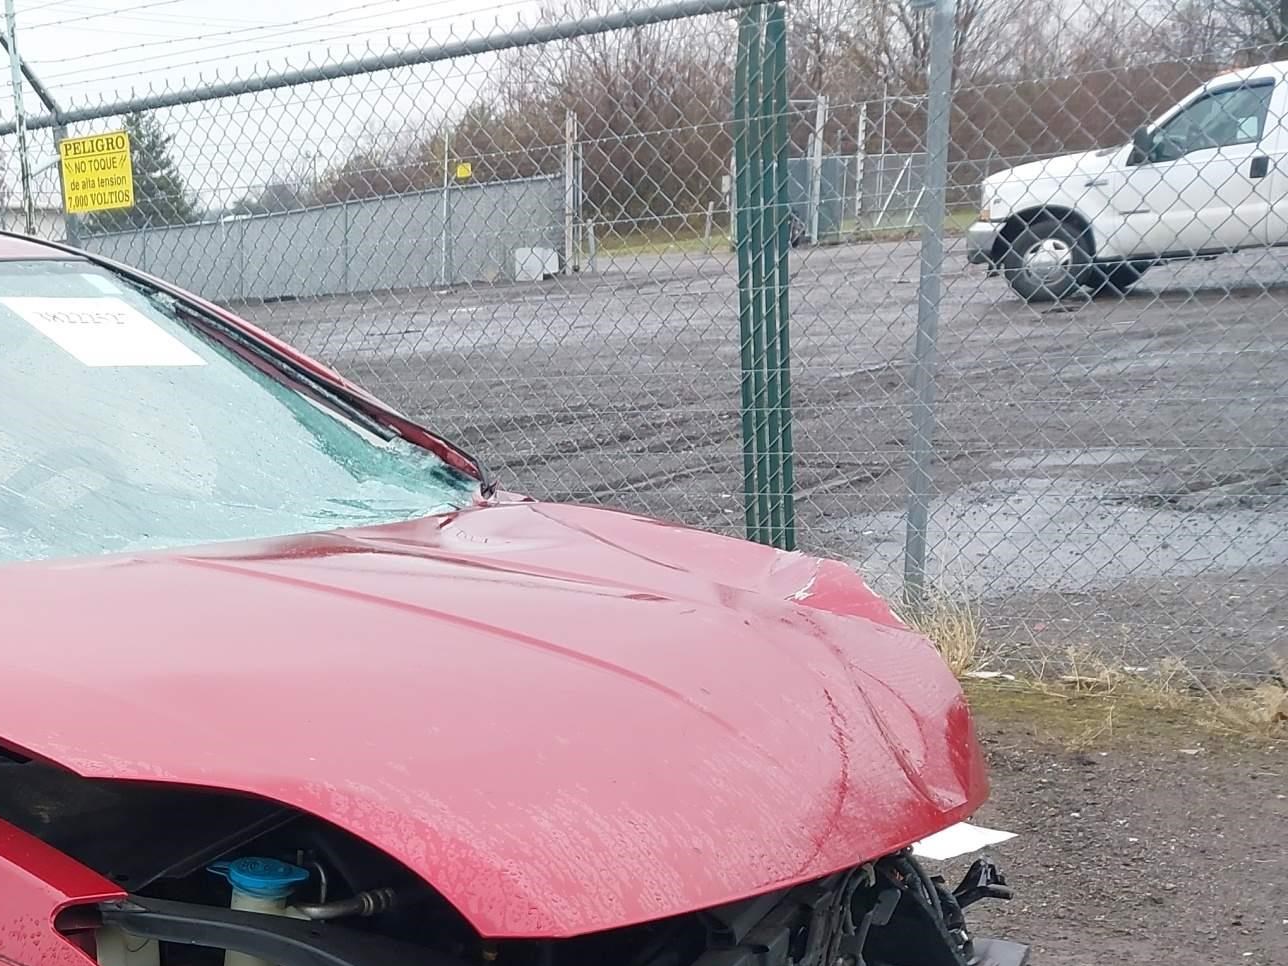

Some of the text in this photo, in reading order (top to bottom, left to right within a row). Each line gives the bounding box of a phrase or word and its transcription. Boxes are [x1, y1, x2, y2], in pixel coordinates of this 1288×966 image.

[64, 135, 125, 156] PELIGRO
[75, 156, 118, 174] NO TOQUE
[71, 174, 127, 191] de alta tension
[90, 189, 130, 206] VOLTIOS
